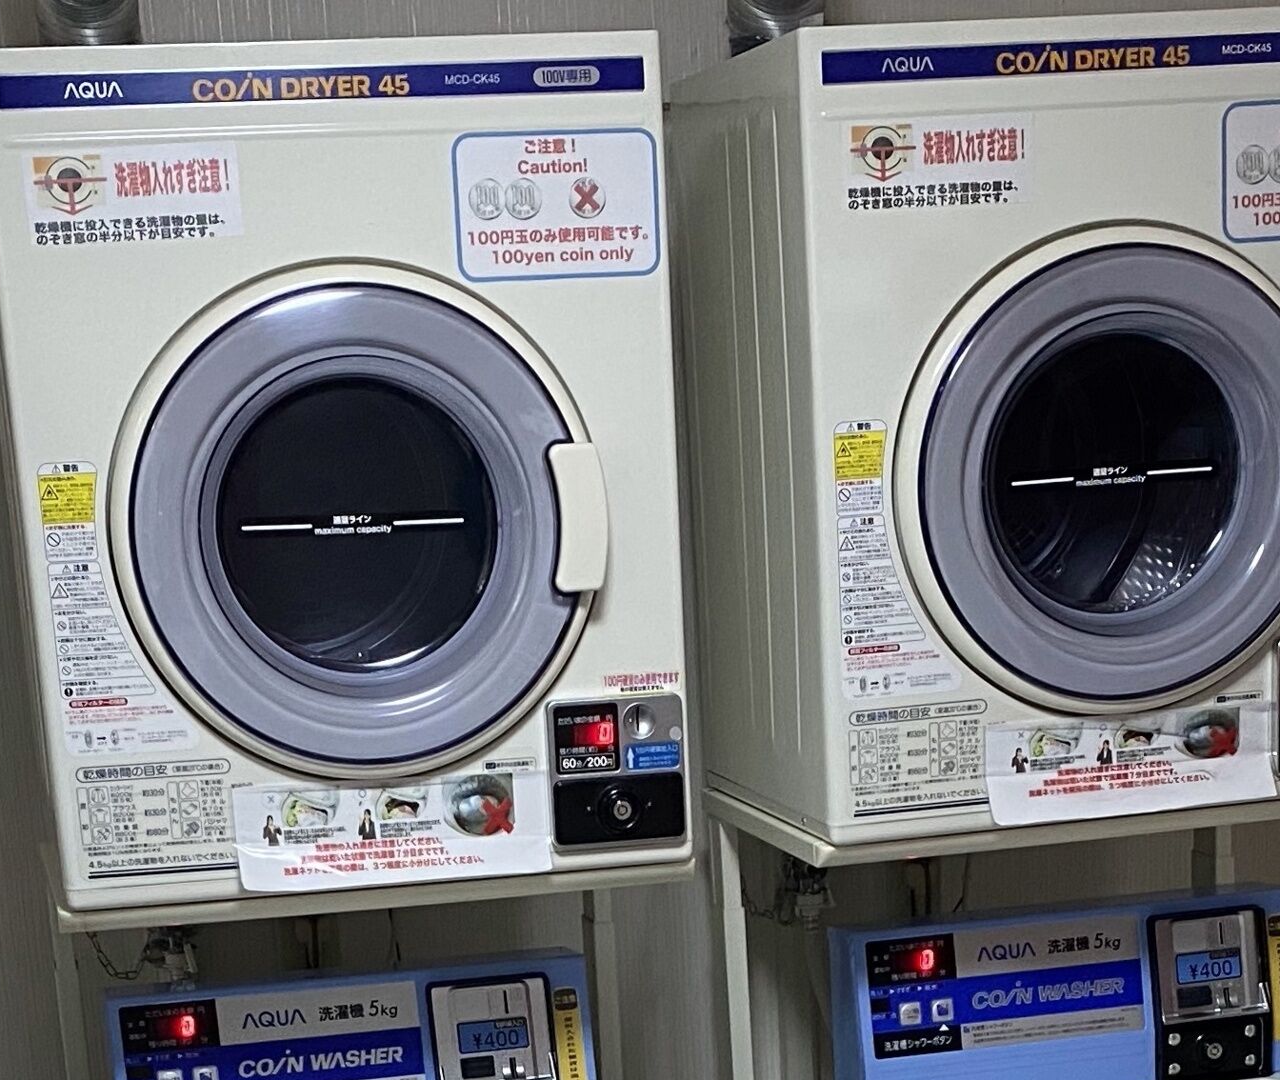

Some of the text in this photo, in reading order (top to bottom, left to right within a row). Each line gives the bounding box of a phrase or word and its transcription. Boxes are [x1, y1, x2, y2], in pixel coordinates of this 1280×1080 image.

[882, 56, 934, 73] AQUA
[1075, 48, 1156, 69] DRYER
[1163, 46, 1190, 65] 45
[64, 81, 123, 100] AQUA
[282, 76, 371, 99] DRYER
[378, 74, 410, 96] 45
[517, 158, 588, 175] Caution!
[468, 225, 650, 246] 100円玉のみ使用可能です。
[491, 246, 634, 267] 100yen coin only
[978, 942, 1036, 962] AQUA
[1048, 933, 1120, 954] 洗濯機 5kg
[1038, 978, 1124, 1002] WASHER
[242, 1009, 307, 1029] AQUA
[319, 1000, 398, 1021] 洗濯機 5kg
[311, 1047, 403, 1071] WASHER
